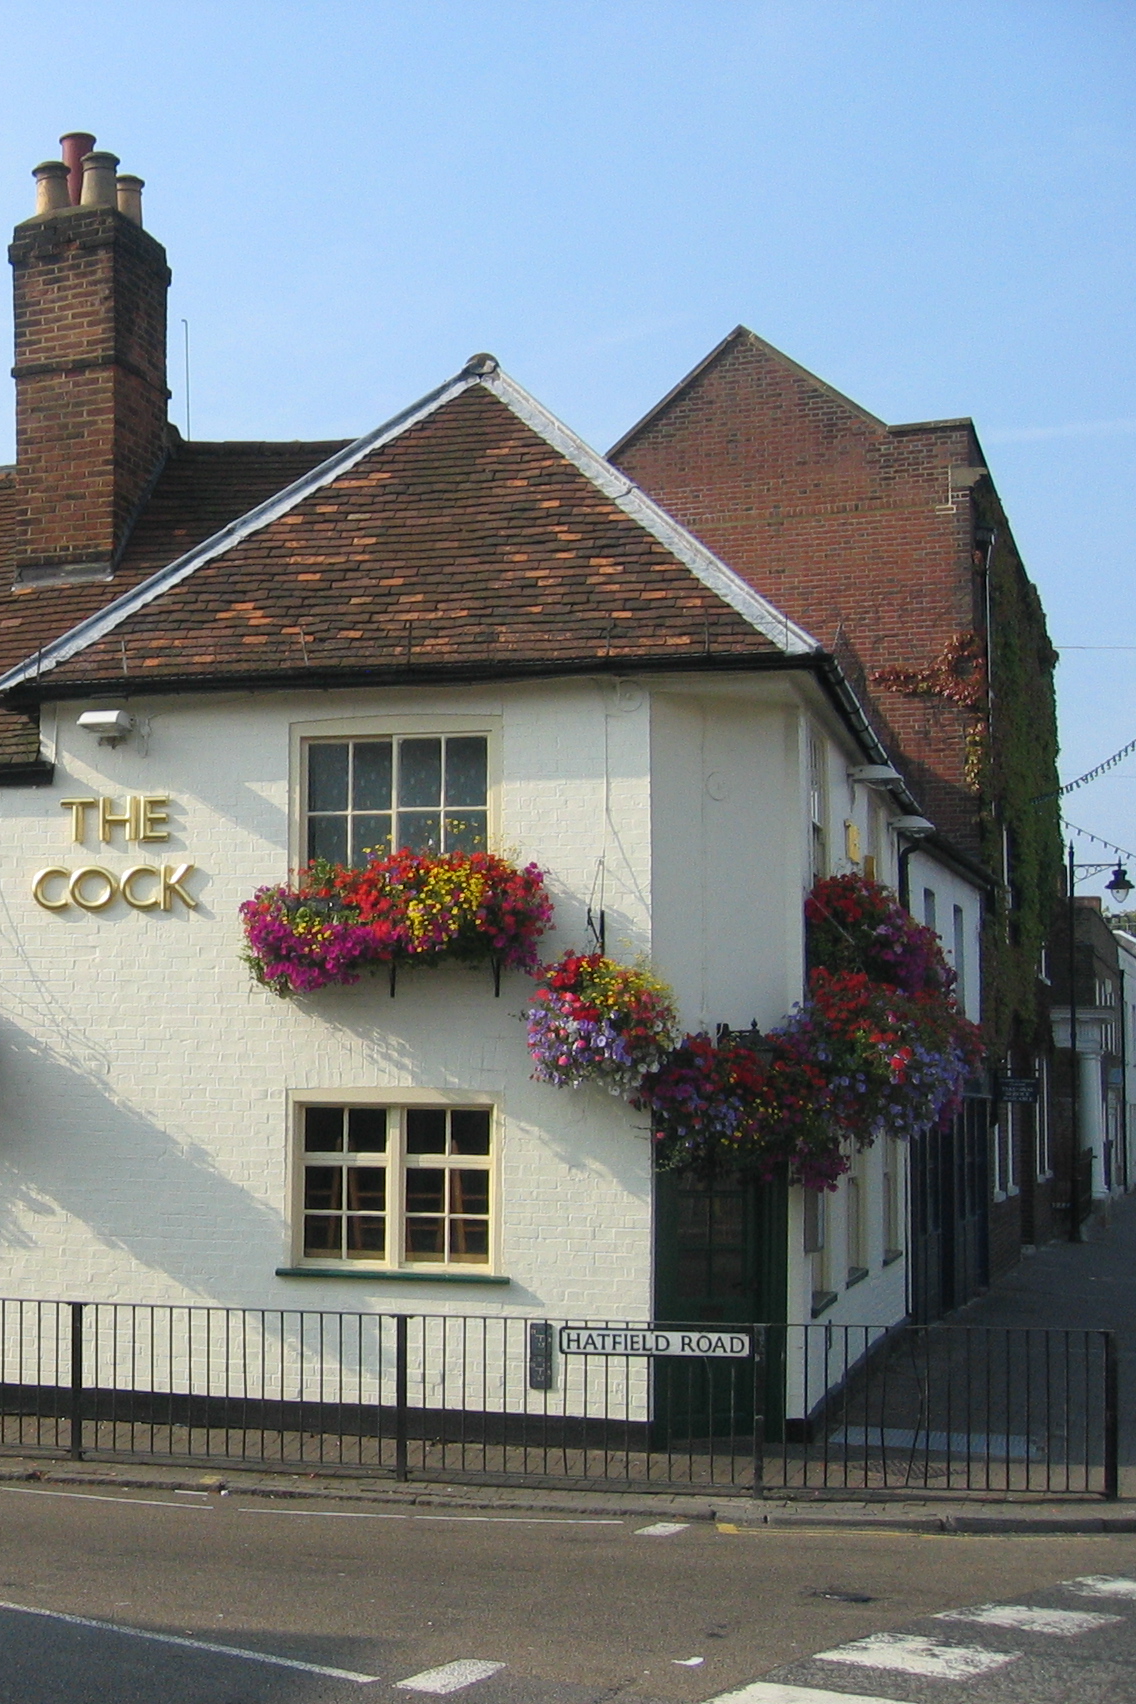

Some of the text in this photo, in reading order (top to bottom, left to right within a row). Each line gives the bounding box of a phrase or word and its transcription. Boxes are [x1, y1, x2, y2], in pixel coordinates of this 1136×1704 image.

[60, 795, 169, 842] THE
[32, 863, 197, 911] COCK
[566, 1332, 670, 1352] HATFIELD
[680, 1335, 745, 1354] ROAD
